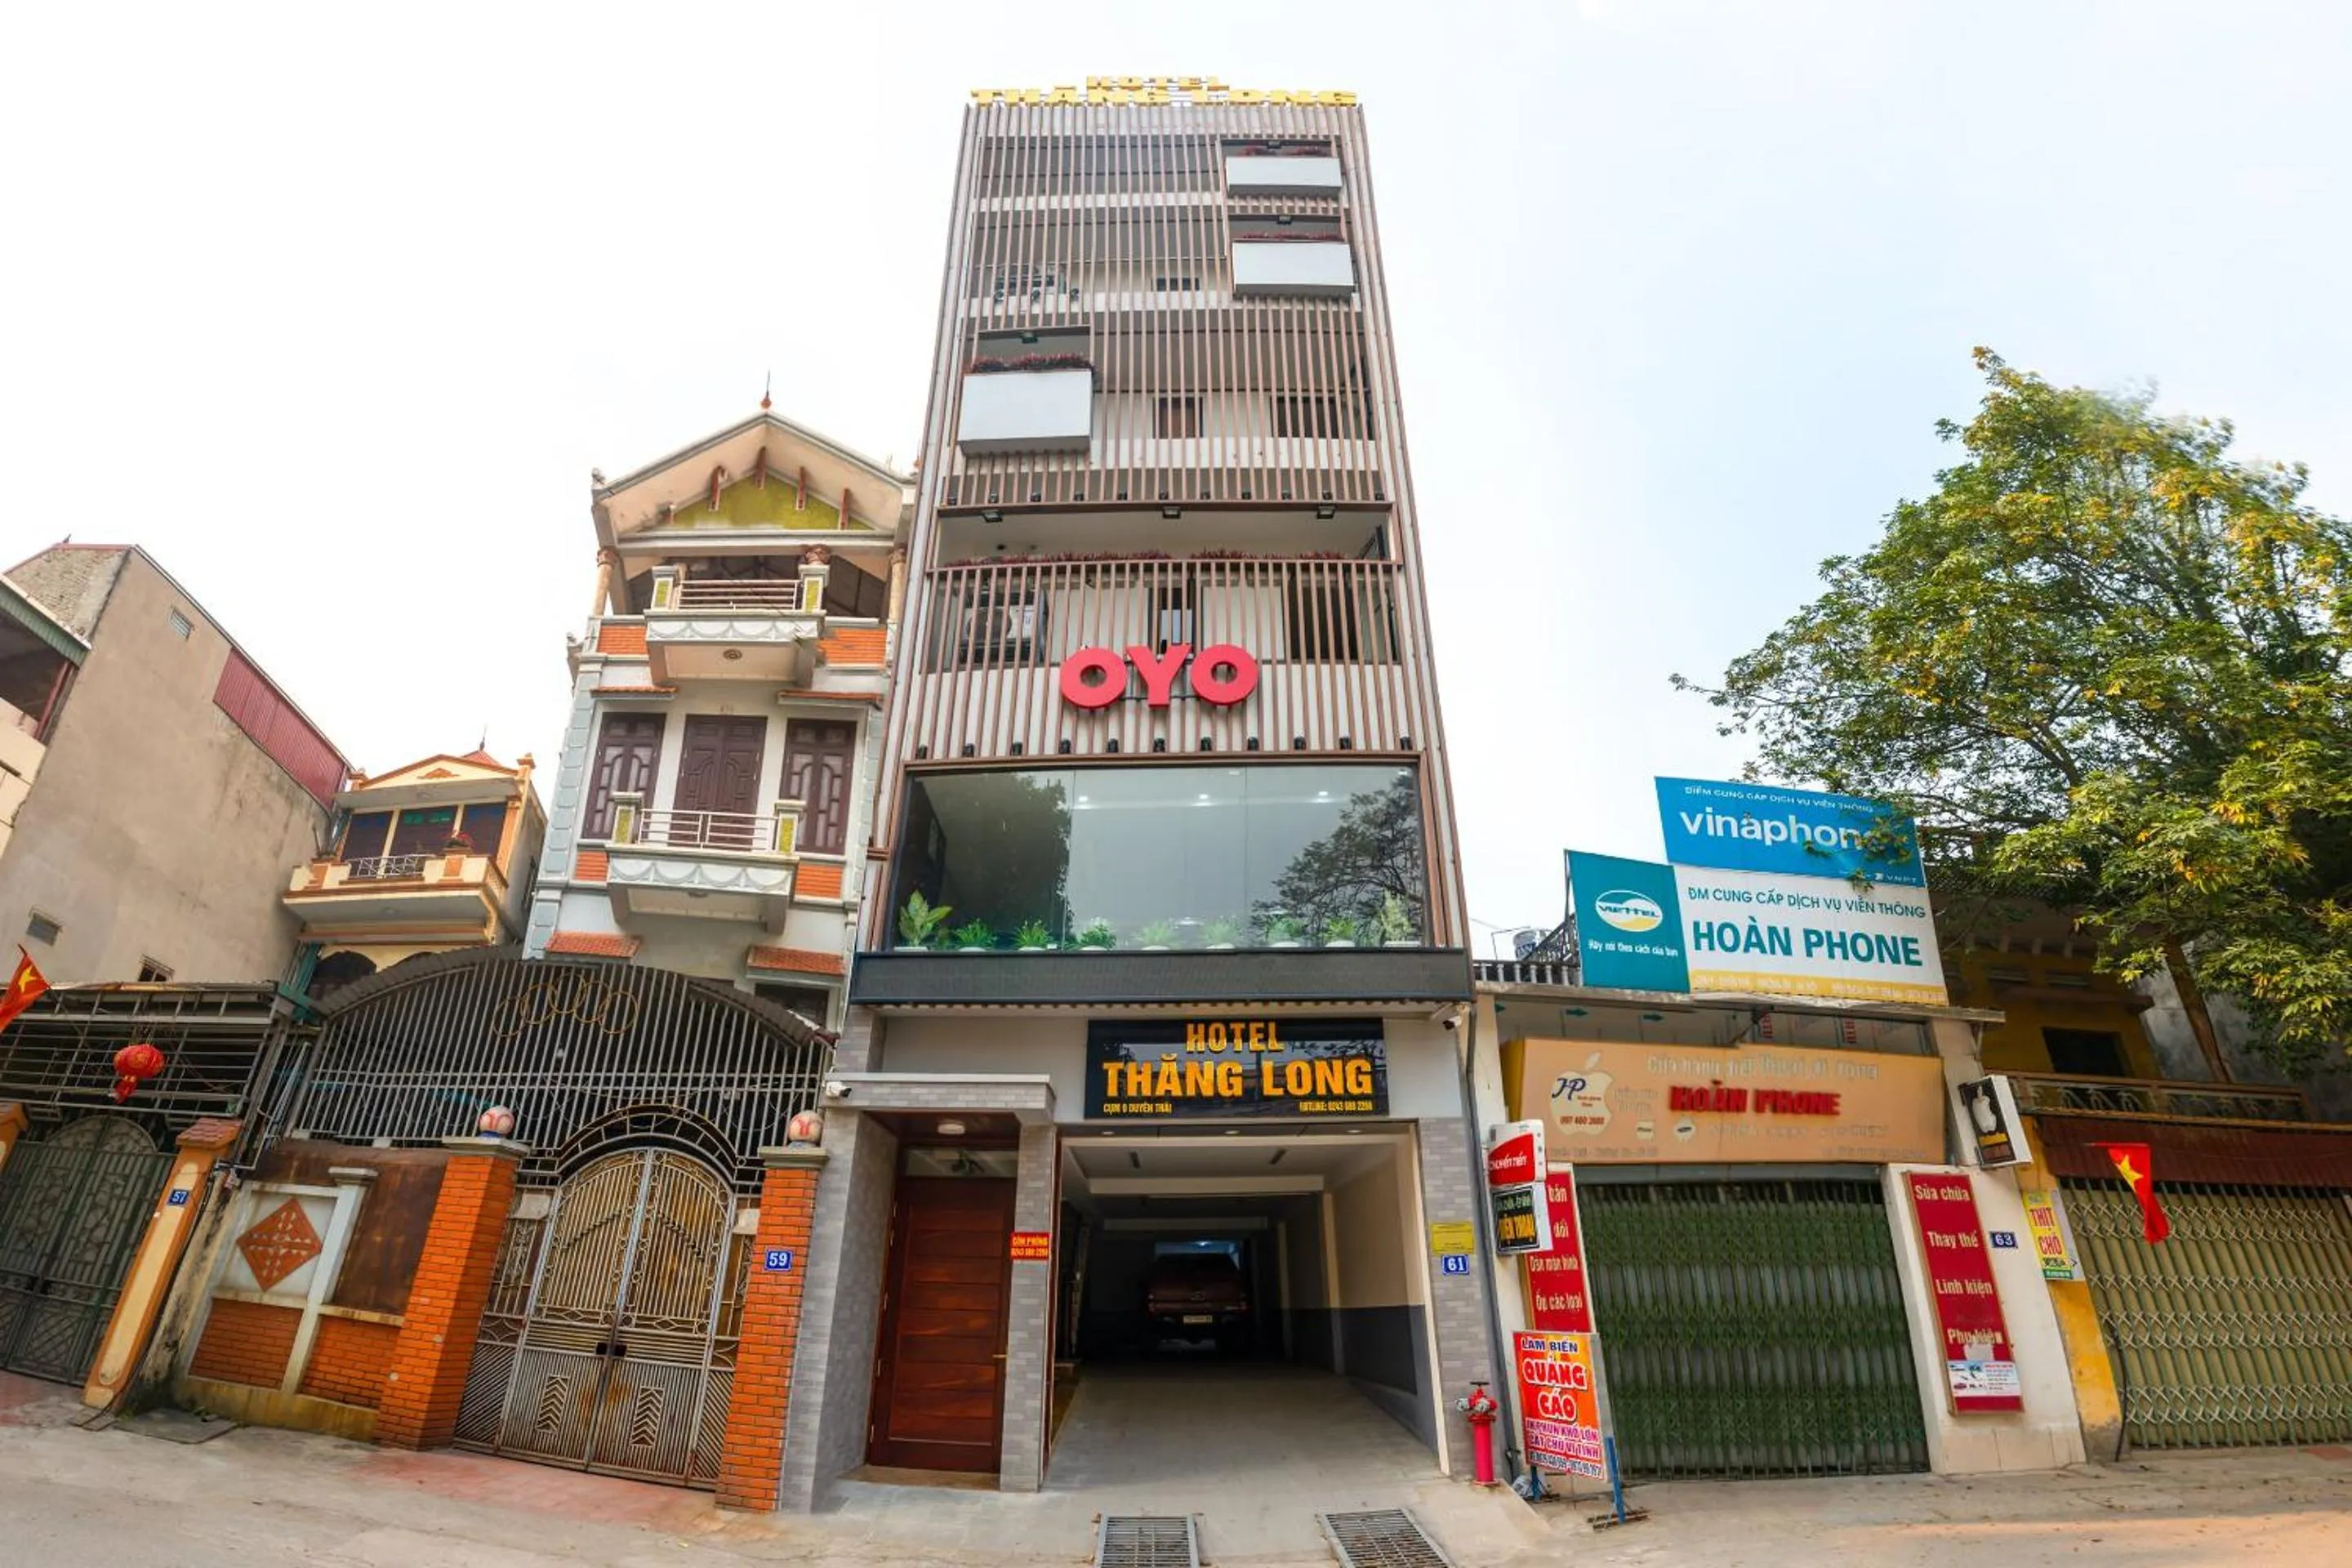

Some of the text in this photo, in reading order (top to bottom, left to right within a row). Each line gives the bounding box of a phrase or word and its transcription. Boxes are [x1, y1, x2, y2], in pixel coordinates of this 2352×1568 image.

[1060, 643, 1258, 709] OYO
[1679, 806, 1881, 851] vinaphon
[1713, 889, 1753, 903] CUNG
[1756, 888, 1784, 904] CẤP
[1787, 893, 1820, 910] DỊCH
[1823, 898, 1842, 913] VỤ
[1878, 900, 1927, 919] THÔNG
[1692, 915, 1923, 966] HOÀN PHONE
[1186, 1022, 1285, 1053] HOTEL
[1102, 1053, 1373, 1098] THĂNG LONG
[1753, 1088, 1842, 1116] PHONE
[172, 1191, 187, 1203] 57
[1914, 1183, 1971, 1203] Sửa chữa
[1927, 1229, 1980, 1250] Thay thế
[1994, 1233, 2014, 1246] 63
[768, 1252, 788, 1267] 59
[1448, 1257, 1464, 1272] 61
[1936, 1278, 1993, 1299] Linh kiện
[1521, 1335, 1546, 1352] LÀM
[1521, 1352, 1588, 1391] QUẢNG
[1537, 1387, 1578, 1423] CÁO
